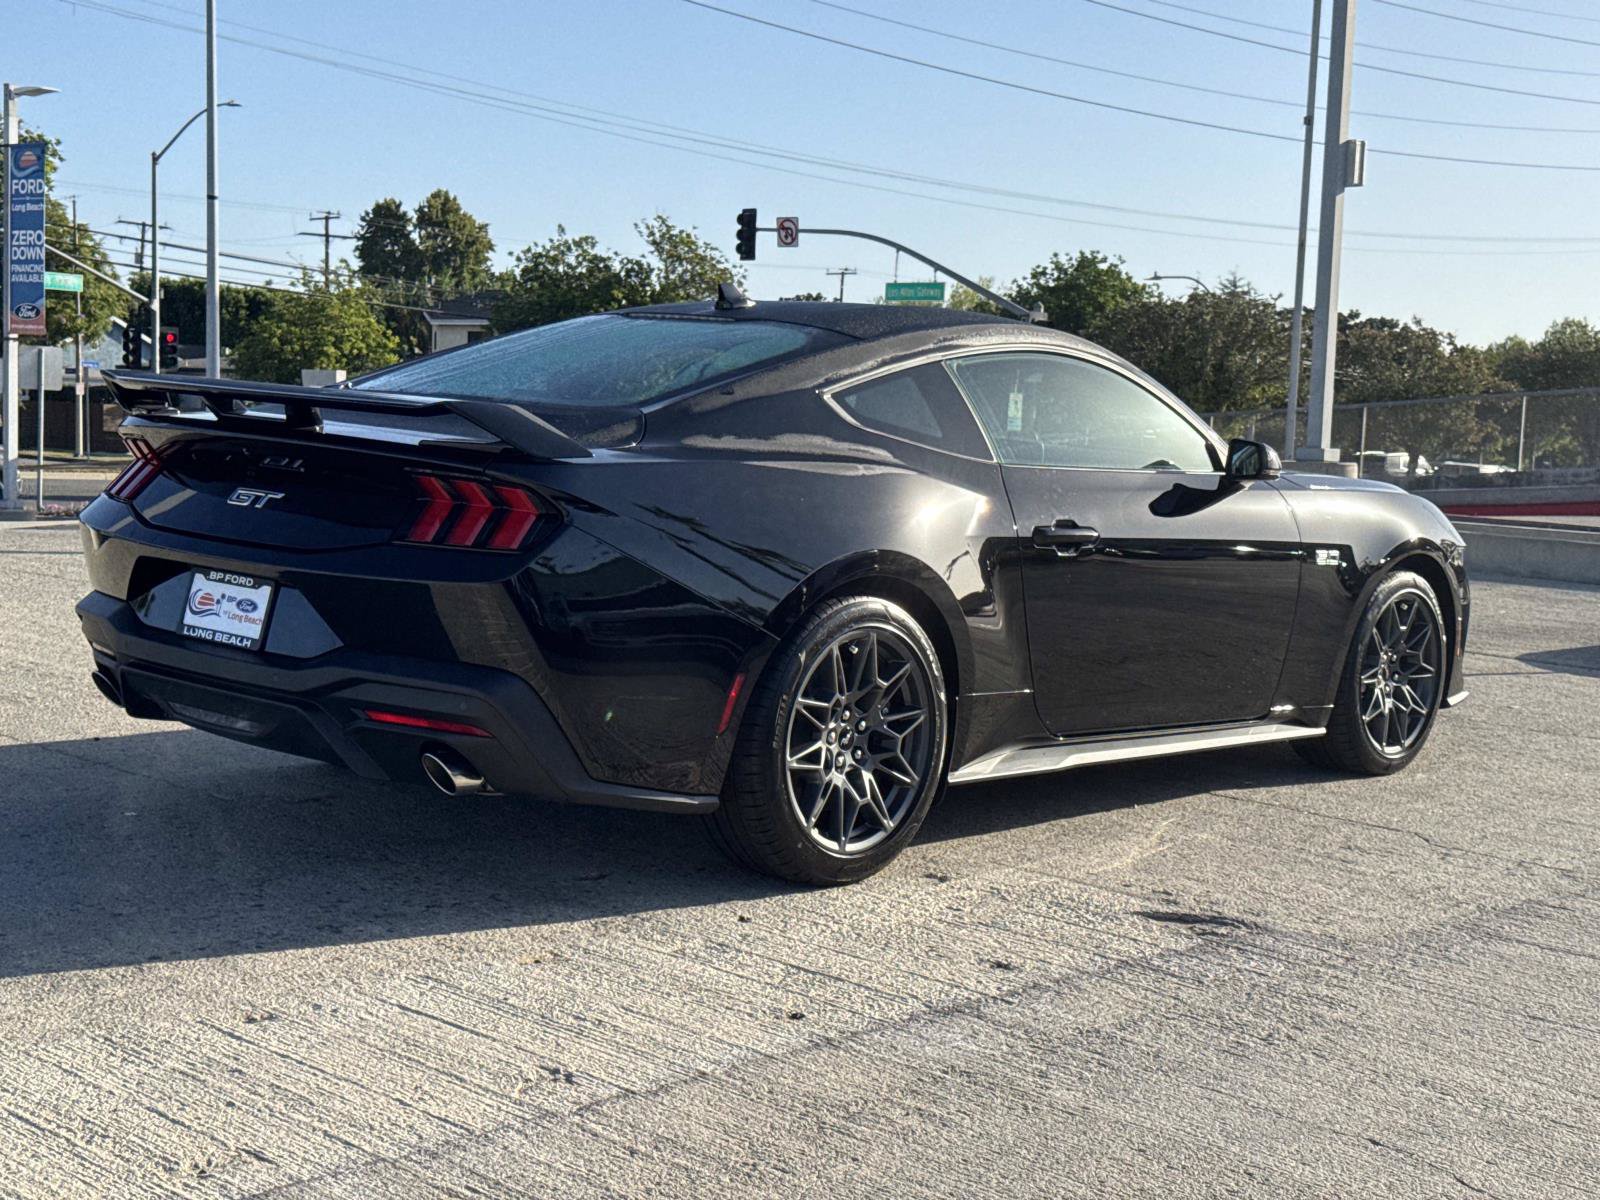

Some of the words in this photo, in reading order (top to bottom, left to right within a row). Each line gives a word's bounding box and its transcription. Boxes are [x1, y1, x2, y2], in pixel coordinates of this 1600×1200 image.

[12, 179, 44, 194] FORD
[12, 203, 26, 212] Long
[26, 203, 44, 211] Beach
[12, 231, 44, 246] ZERO
[12, 247, 44, 260] DOWN
[12, 264, 44, 272] FINANCING
[12, 274, 44, 282] AVAILABLE
[18, 306, 37, 318] Ford
[226, 488, 285, 508] GT
[210, 571, 224, 580] BP
[225, 574, 253, 586] FORD
[240, 600, 254, 611] Ford
[228, 612, 243, 623] Long
[244, 614, 262, 625] Beach
[183, 626, 213, 640] LONG
[215, 631, 251, 648] BEACH
